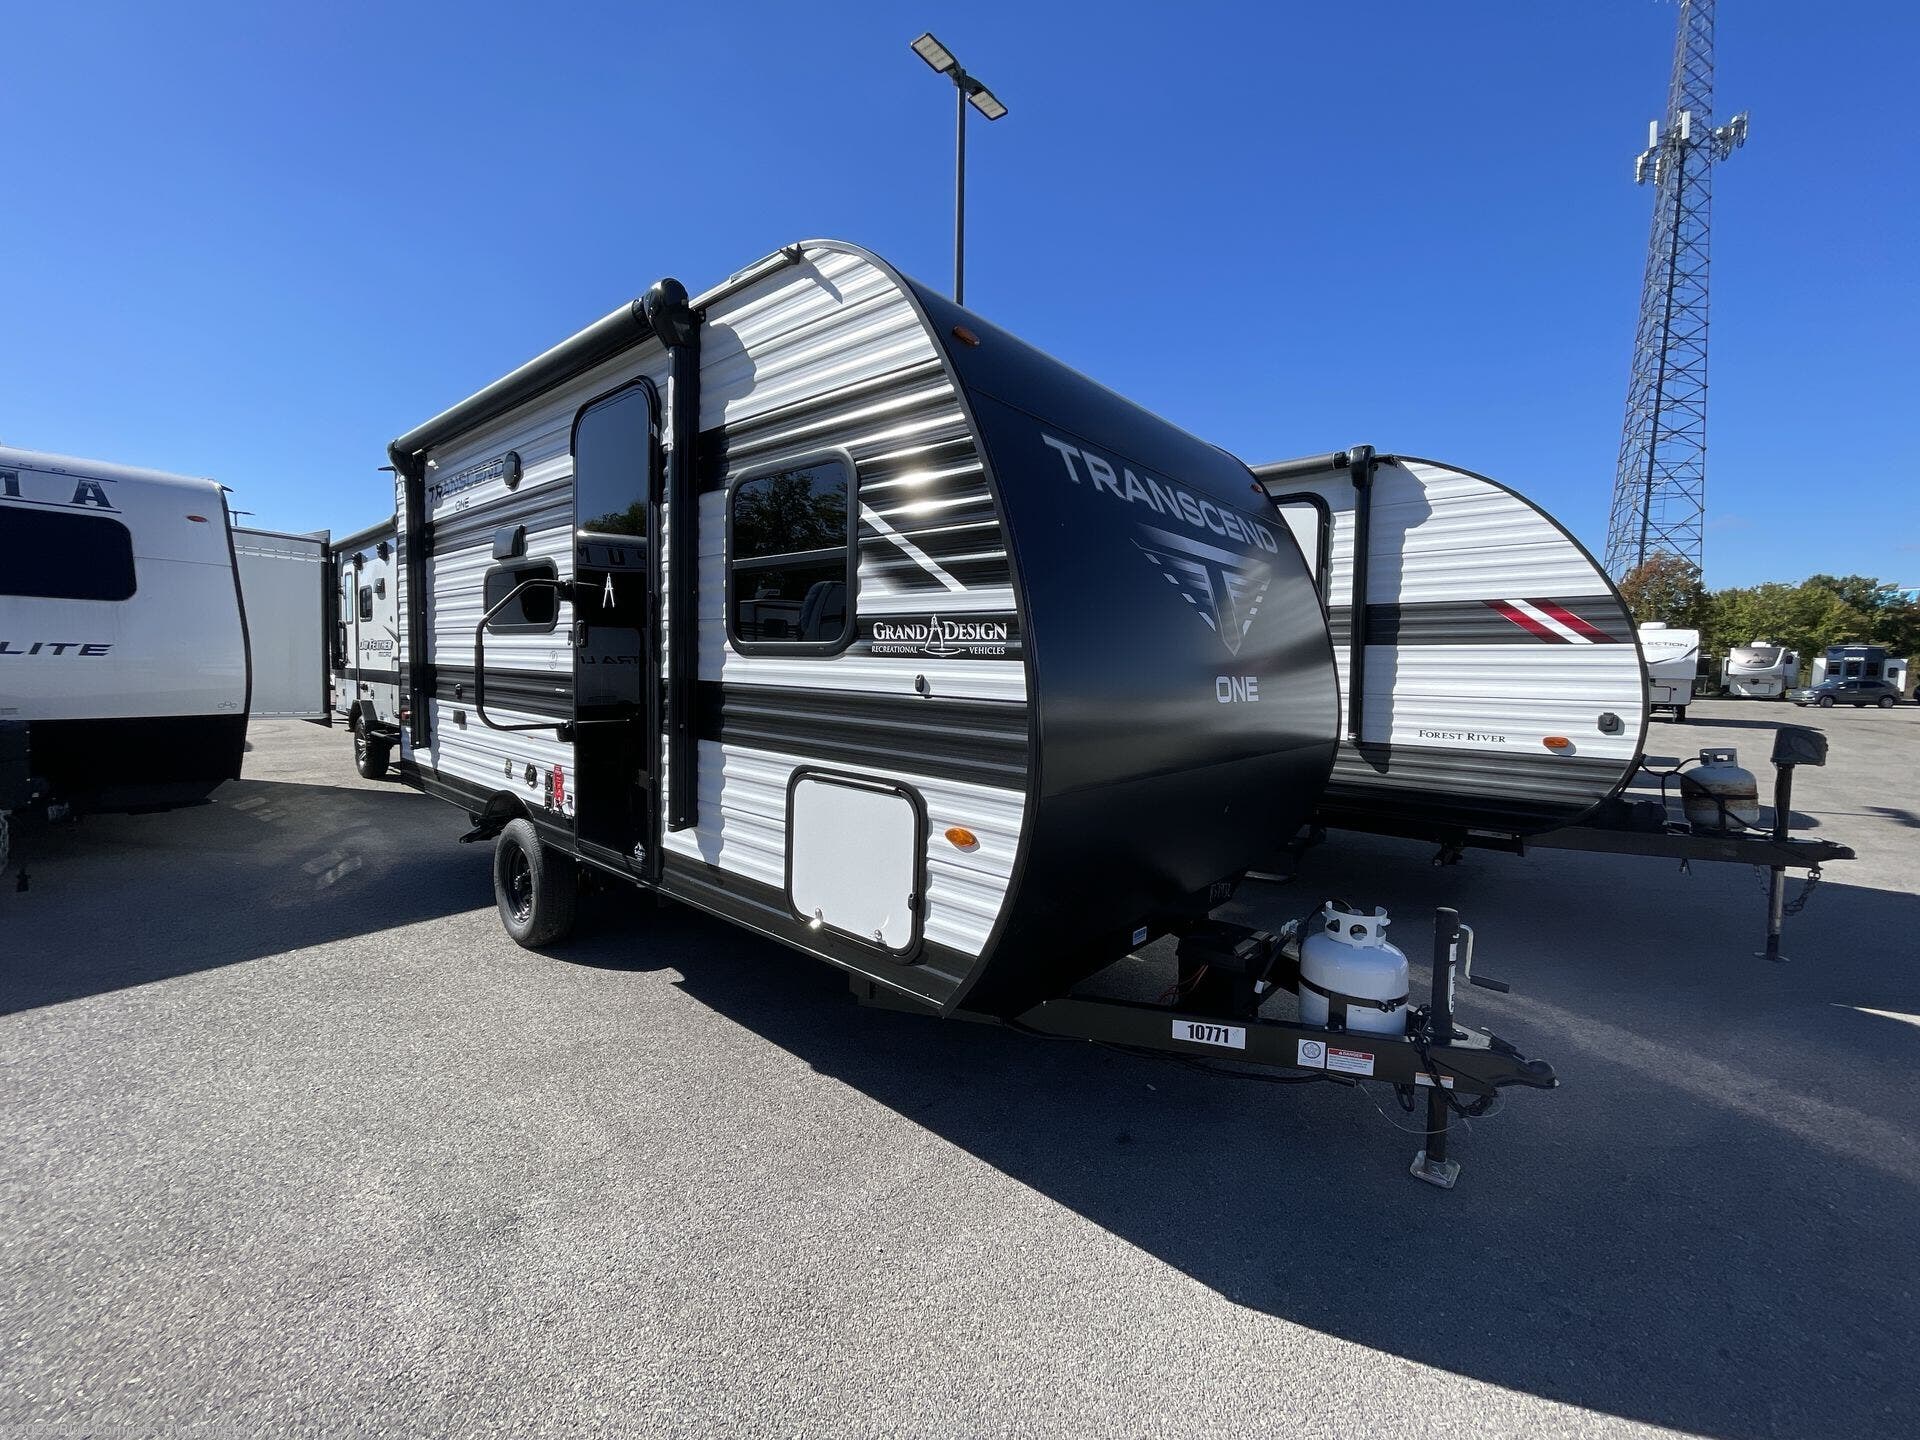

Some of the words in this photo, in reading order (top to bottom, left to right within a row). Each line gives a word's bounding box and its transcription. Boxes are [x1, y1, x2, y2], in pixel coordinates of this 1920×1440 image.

[1041, 433, 1278, 554] TRANSCEND
[872, 622, 928, 640] GRAND
[942, 621, 1008, 640] DESIGN
[0, 641, 114, 656] LITE
[871, 645, 918, 654] RECREATIONAL
[969, 646, 1006, 655] VEHICLES
[1215, 676, 1259, 703] ONE
[1418, 729, 1463, 741] FOREST
[1466, 732, 1506, 743] RIVER
[1187, 1023, 1229, 1044] 10771
